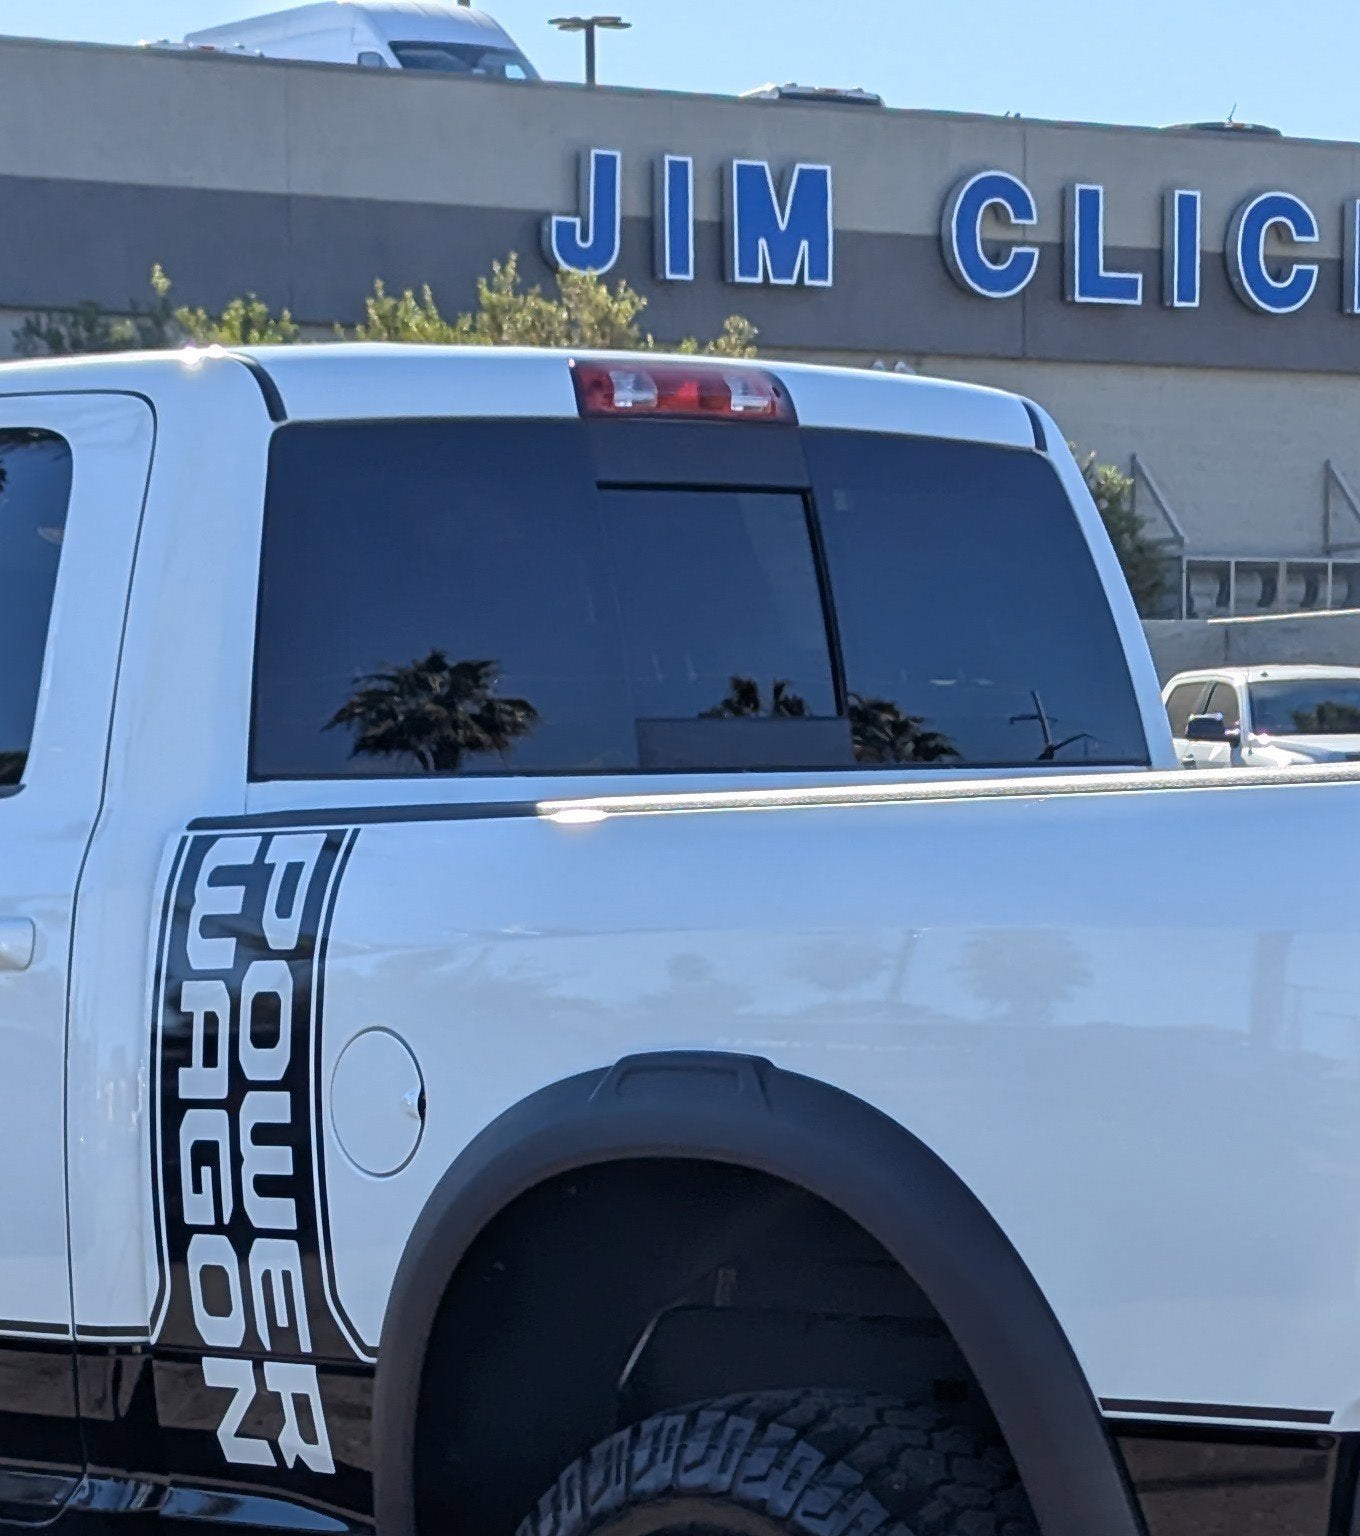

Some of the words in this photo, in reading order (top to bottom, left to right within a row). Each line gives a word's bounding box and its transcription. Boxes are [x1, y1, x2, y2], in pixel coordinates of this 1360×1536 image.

[547, 147, 834, 287] JIM
[178, 835, 276, 1467] WAGON
[239, 833, 336, 1474] POWER
